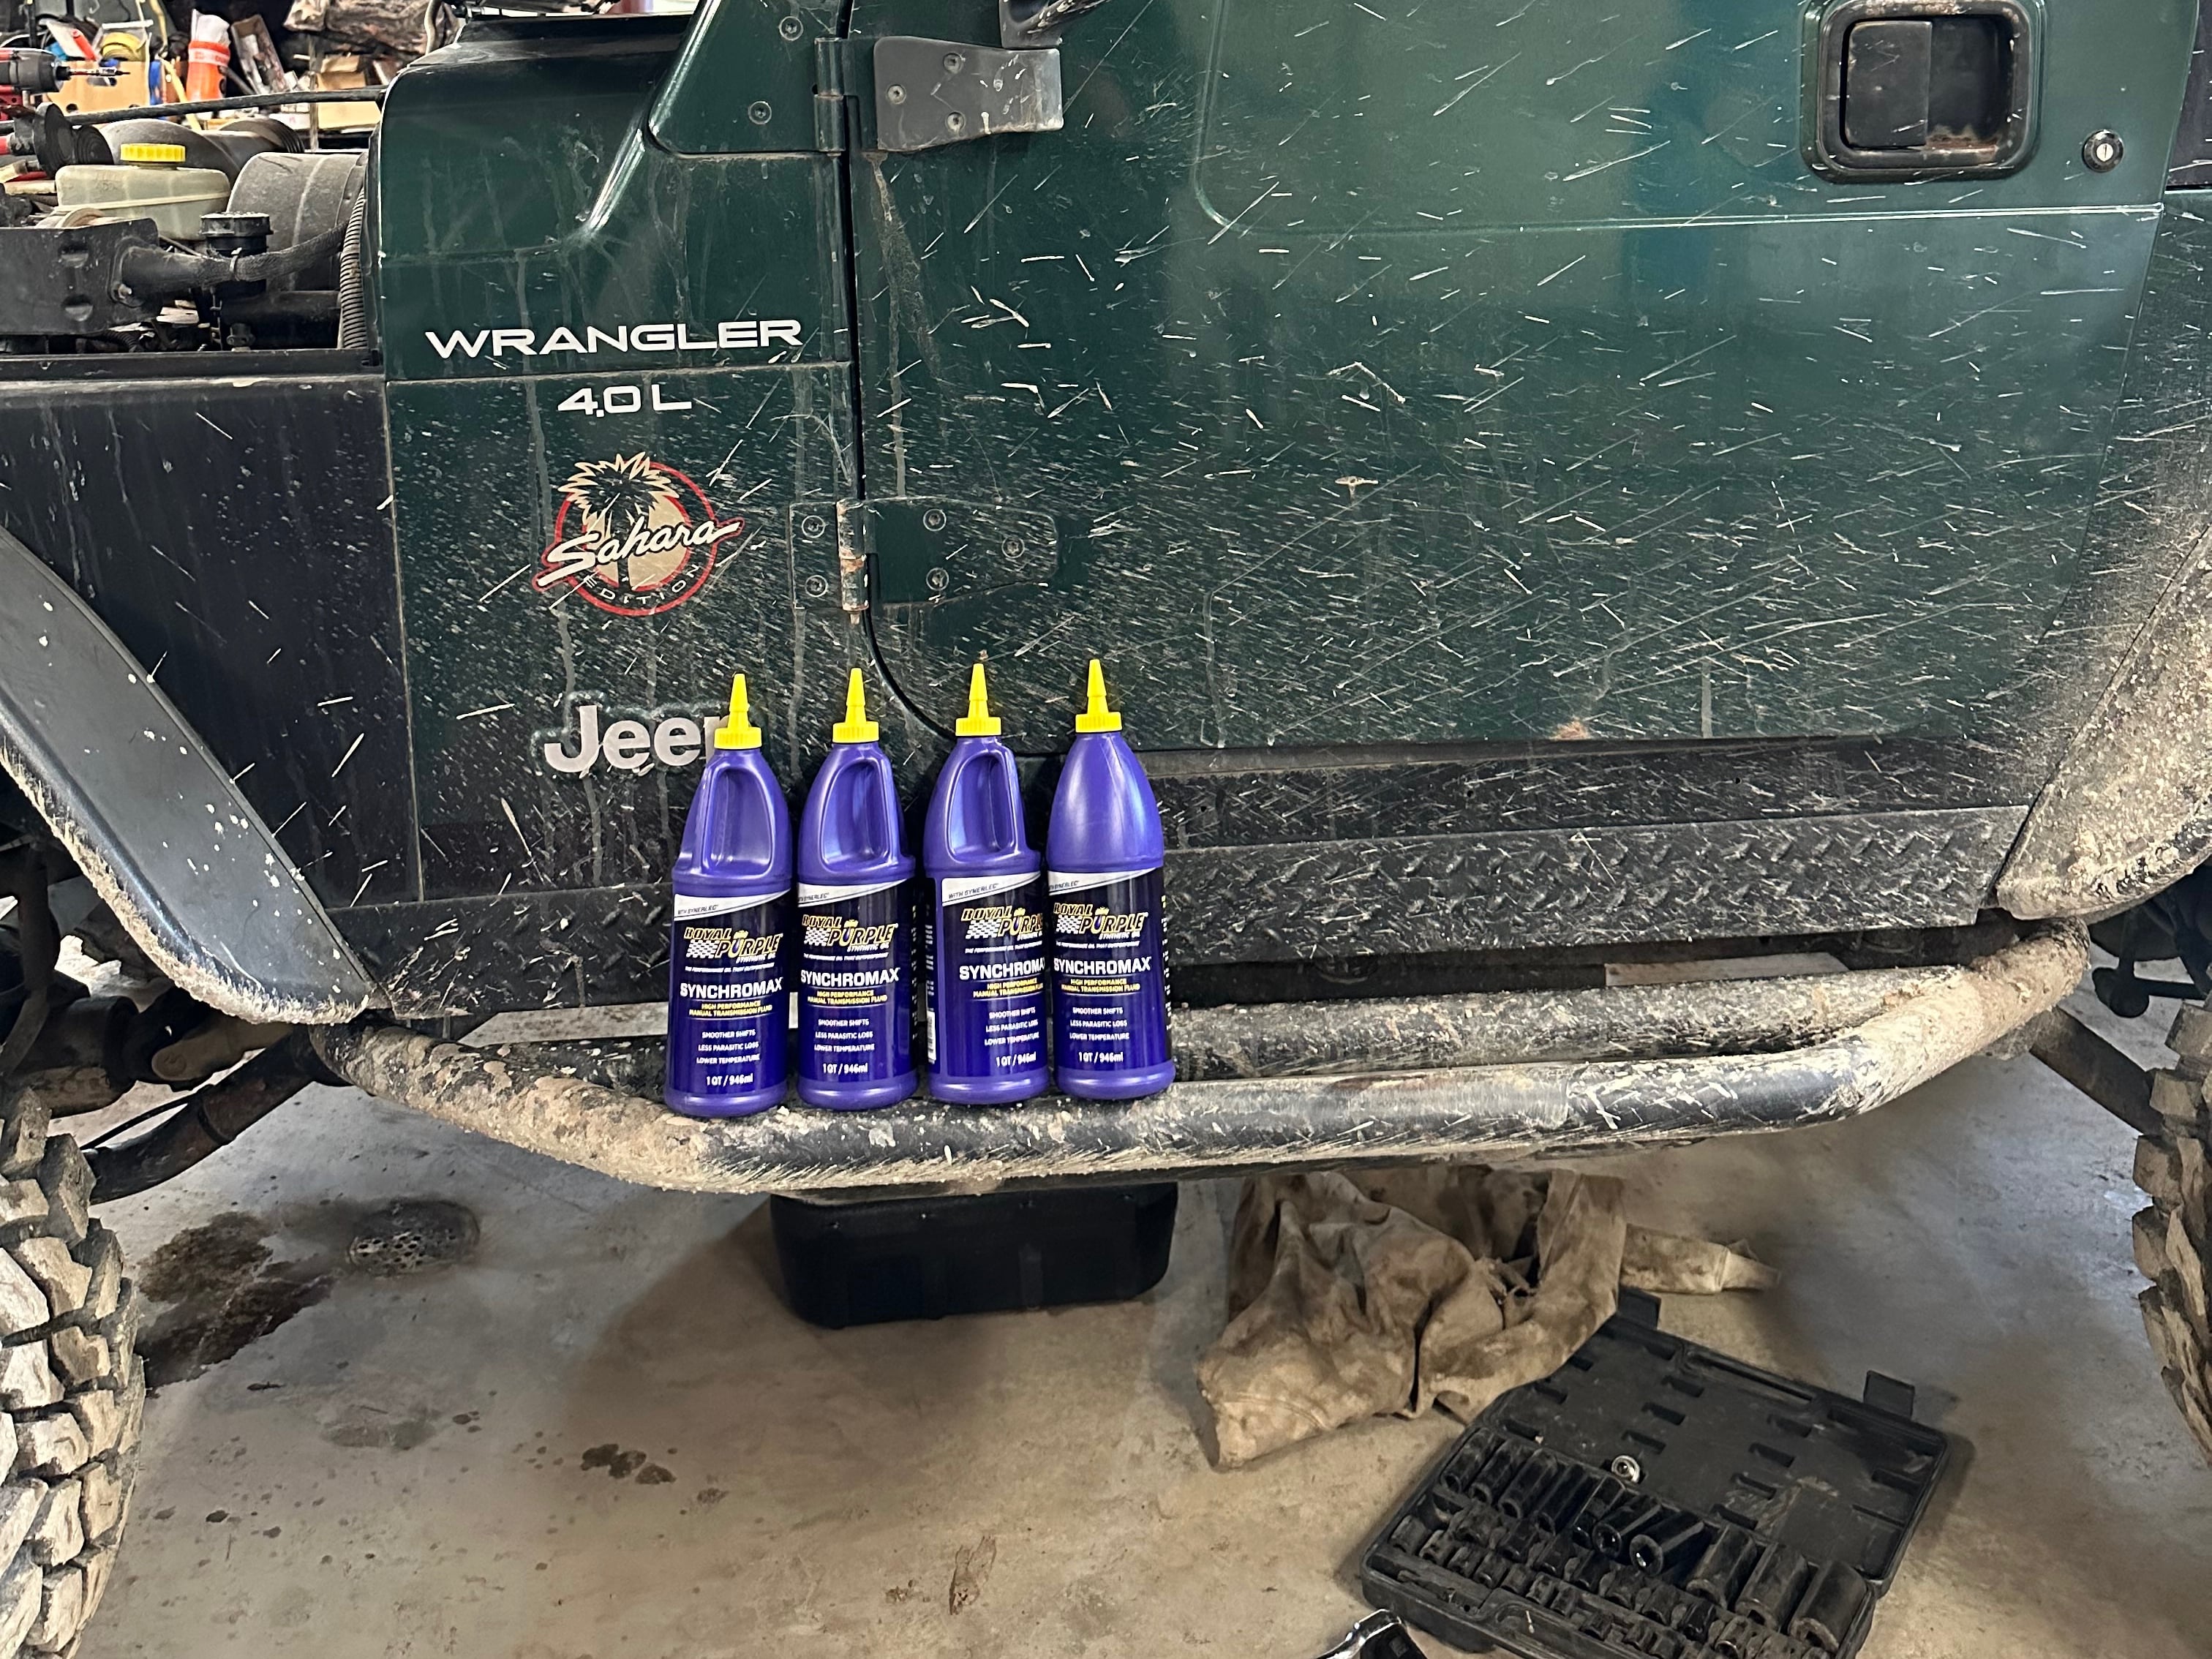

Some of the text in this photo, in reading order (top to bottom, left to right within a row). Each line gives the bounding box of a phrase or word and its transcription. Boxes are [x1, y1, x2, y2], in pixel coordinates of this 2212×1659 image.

[425, 320, 803, 358] WRANGLER
[557, 384, 692, 418] 4.0 L
[537, 516, 741, 587] Sahara
[585, 564, 699, 604] EDITION
[960, 906, 1012, 921] ROYAL
[1053, 903, 1094, 915] ROYAL
[802, 914, 842, 929] ROYAL
[998, 913, 1043, 936] PURPL
[1079, 912, 1146, 934] PURPLE
[684, 927, 732, 940] ROYAL
[827, 923, 896, 947] PURPLE
[715, 933, 781, 958] PURPLE
[1053, 957, 1151, 975] SYNCHROMAX
[801, 968, 900, 987] SYNCHROMAX
[680, 978, 782, 999] SYNCHROMAX
[989, 1009, 1020, 1019] SMOOTHER
[736, 1029, 756, 1038] SHIFTS
[986, 1025, 1000, 1033] LESS
[985, 1038, 1007, 1046] LOWER
[1088, 1033, 1129, 1041] TEMPERATURE
[745, 1042, 759, 1050] LOSS
[833, 1044, 875, 1052] TEMPERATURE
[719, 1053, 760, 1064] TEMPERATURE
[1099, 1052, 1124, 1063] 946ml
[844, 1063, 868, 1074] 946ml
